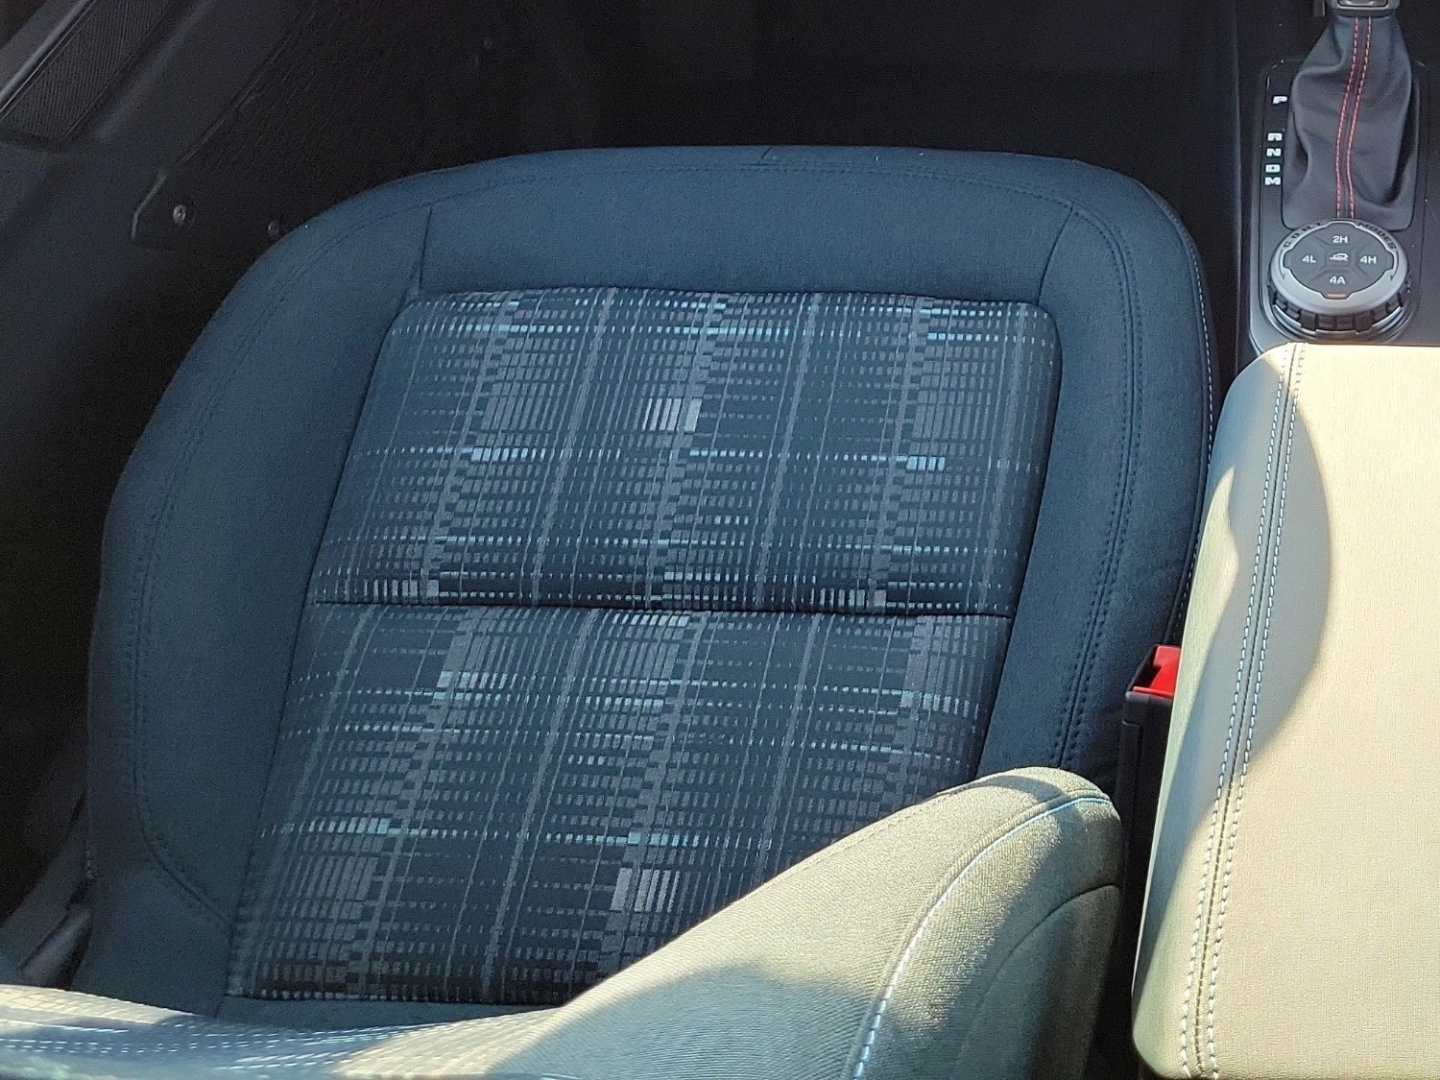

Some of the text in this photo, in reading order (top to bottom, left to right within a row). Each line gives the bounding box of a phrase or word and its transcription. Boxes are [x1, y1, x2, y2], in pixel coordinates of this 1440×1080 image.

[1272, 95, 1288, 105] P
[1266, 148, 1281, 157] N
[1265, 176, 1281, 186] M
[1332, 235, 1349, 244] 2H
[1301, 255, 1317, 263] 4L
[1360, 255, 1377, 264] 4H
[1329, 276, 1346, 284] 4A
